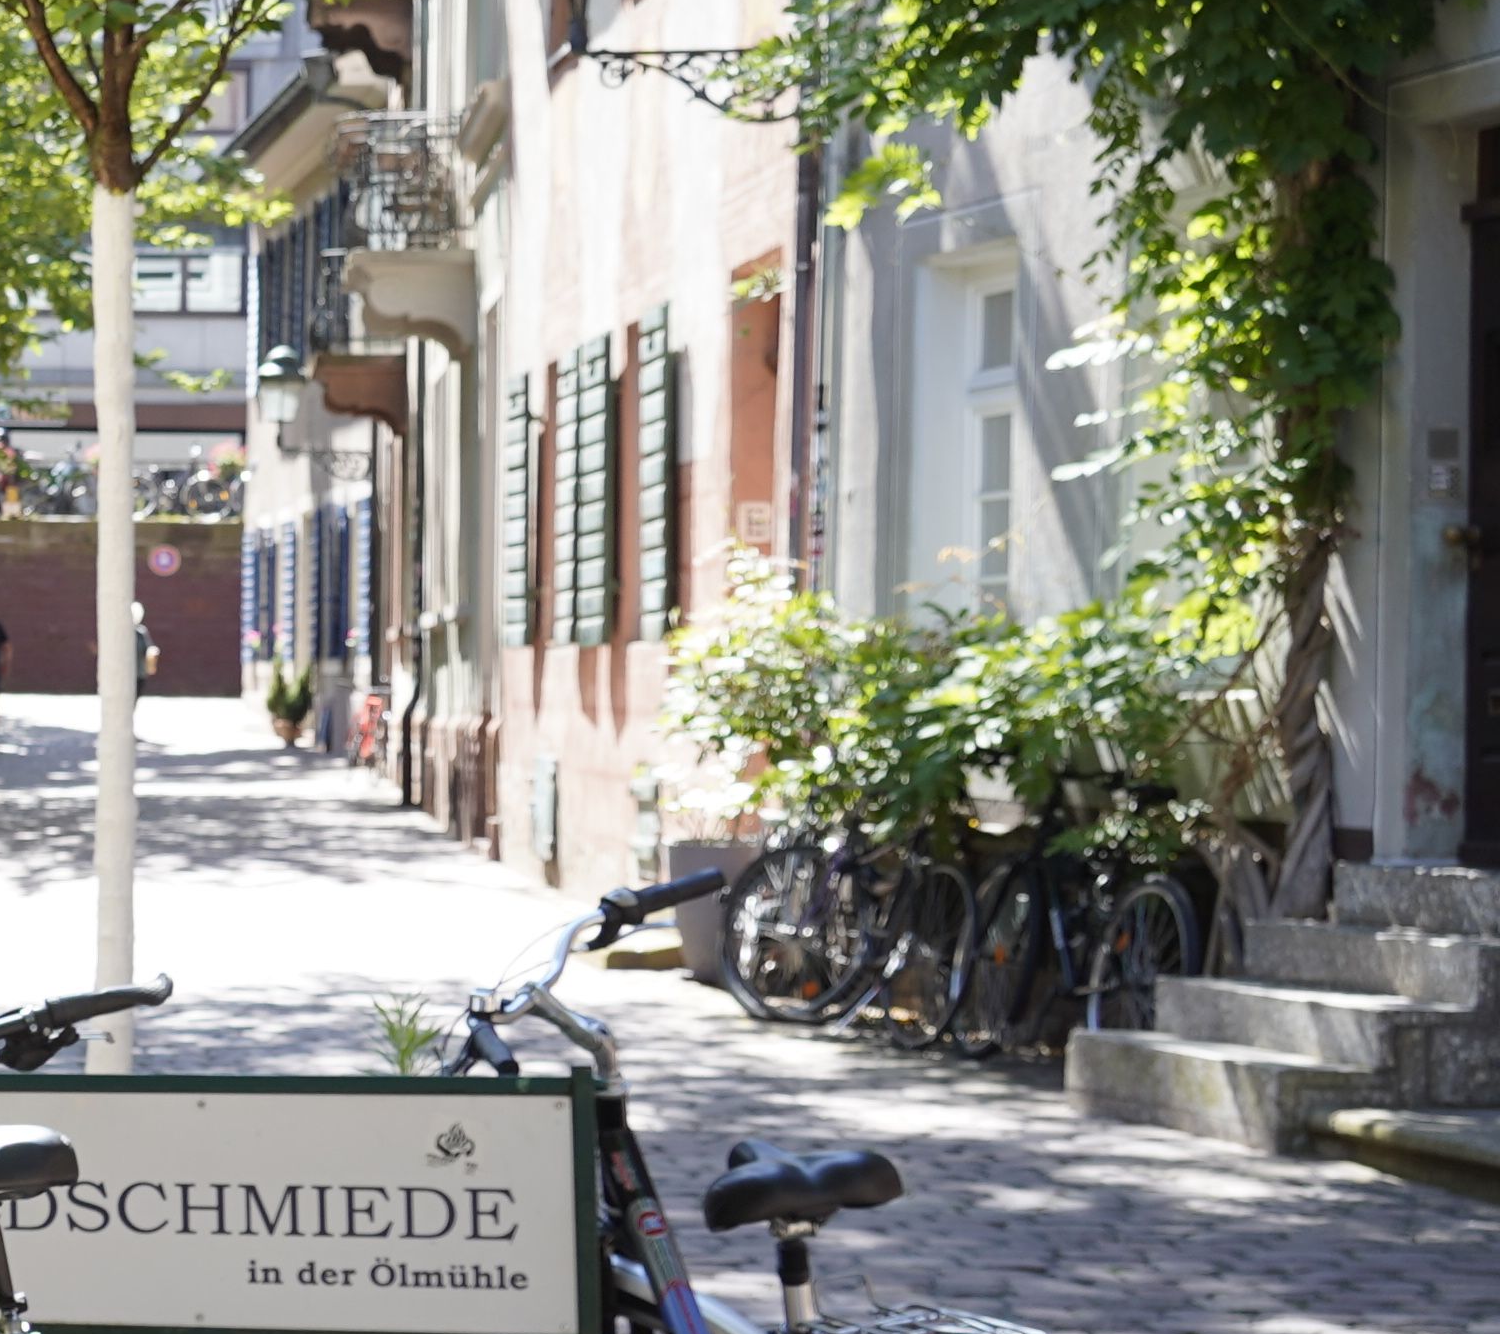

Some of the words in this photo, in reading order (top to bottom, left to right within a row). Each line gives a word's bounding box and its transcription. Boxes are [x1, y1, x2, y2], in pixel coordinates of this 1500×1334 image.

[248, 1260, 284, 1285] in
[298, 1260, 357, 1286] der
[370, 1257, 529, 1290] Ölmühle
